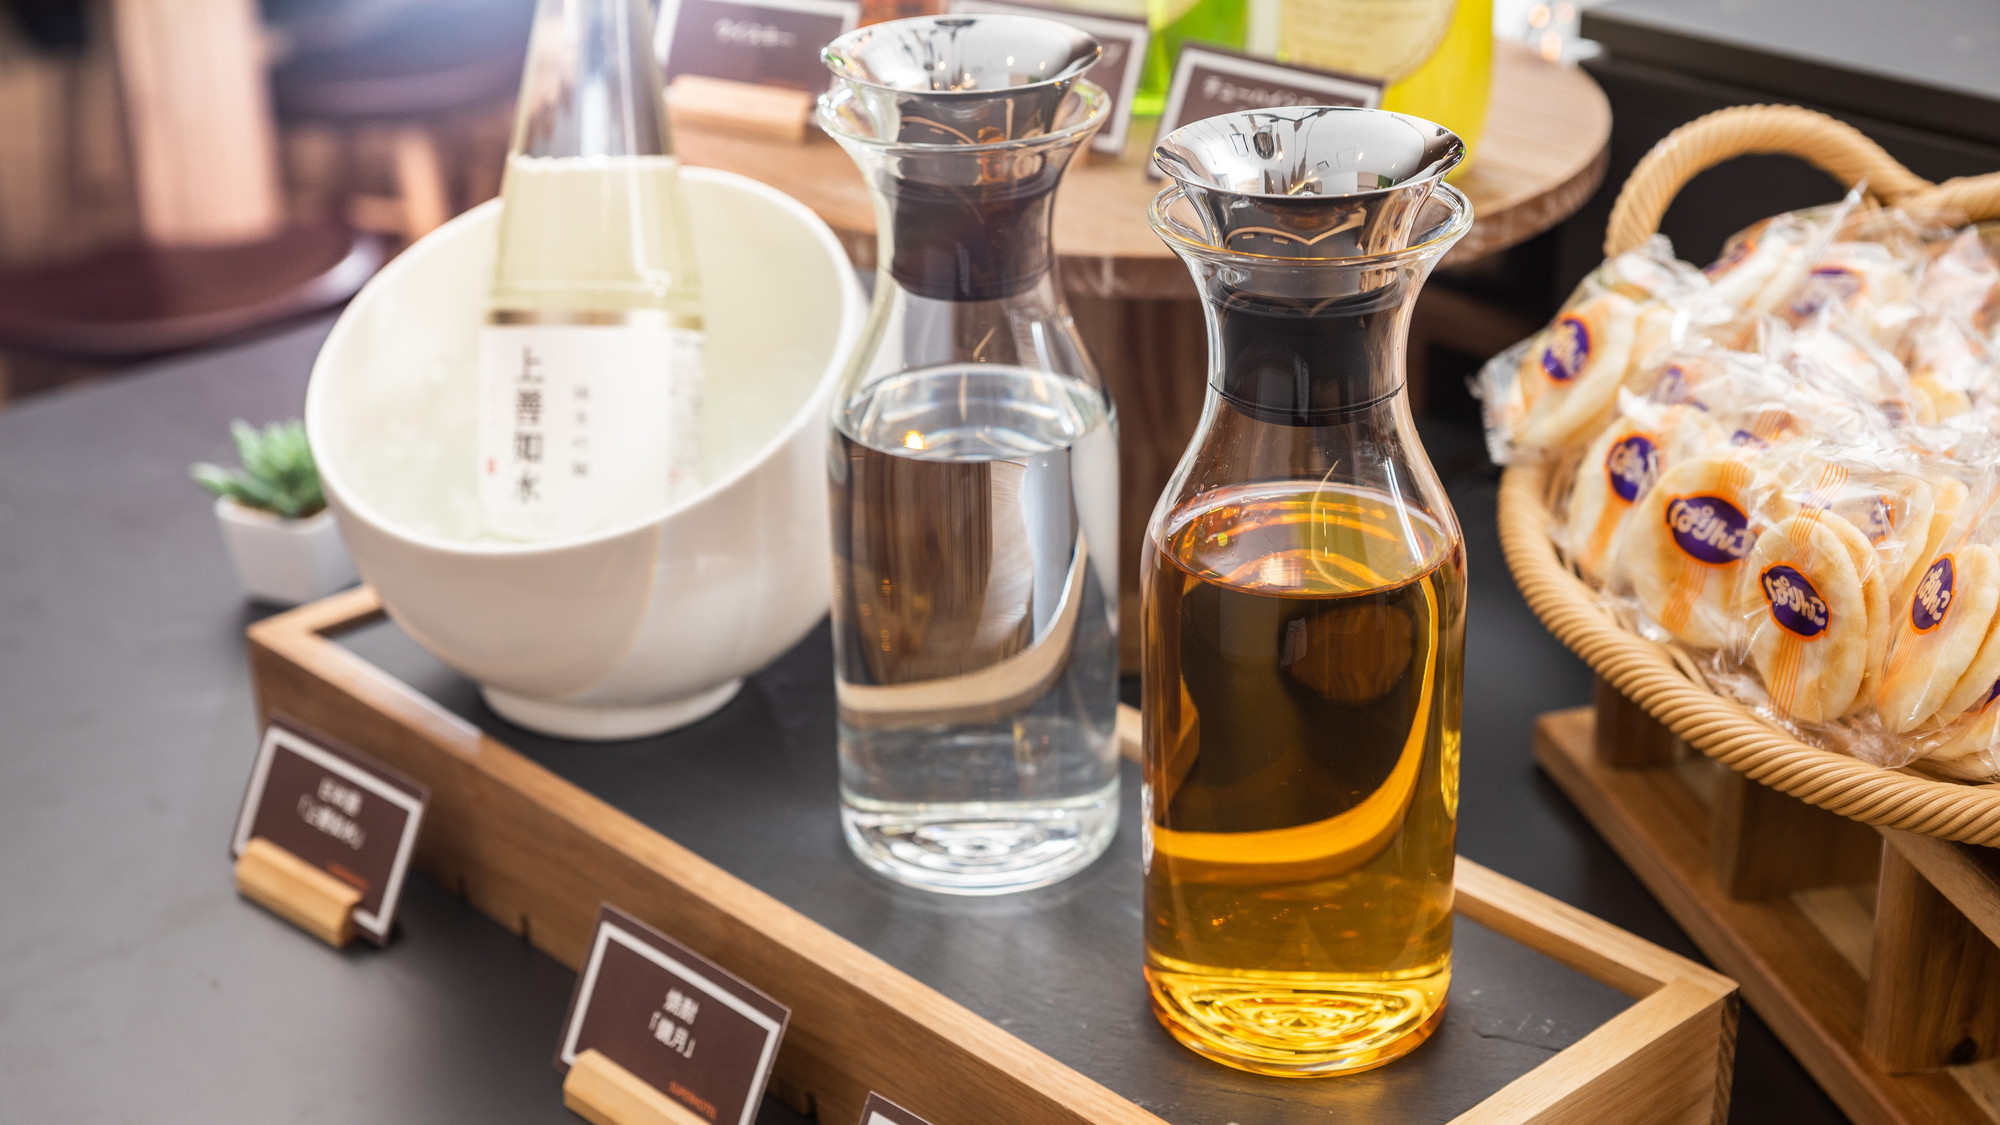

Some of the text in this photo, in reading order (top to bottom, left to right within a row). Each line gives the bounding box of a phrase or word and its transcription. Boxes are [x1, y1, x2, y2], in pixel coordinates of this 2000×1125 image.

[514, 345, 545, 504] 上善如水
[1669, 500, 1756, 558] ぱりんこ
[1765, 575, 1826, 627] ぱりんこ
[1916, 567, 1951, 621] ぱりんこ
